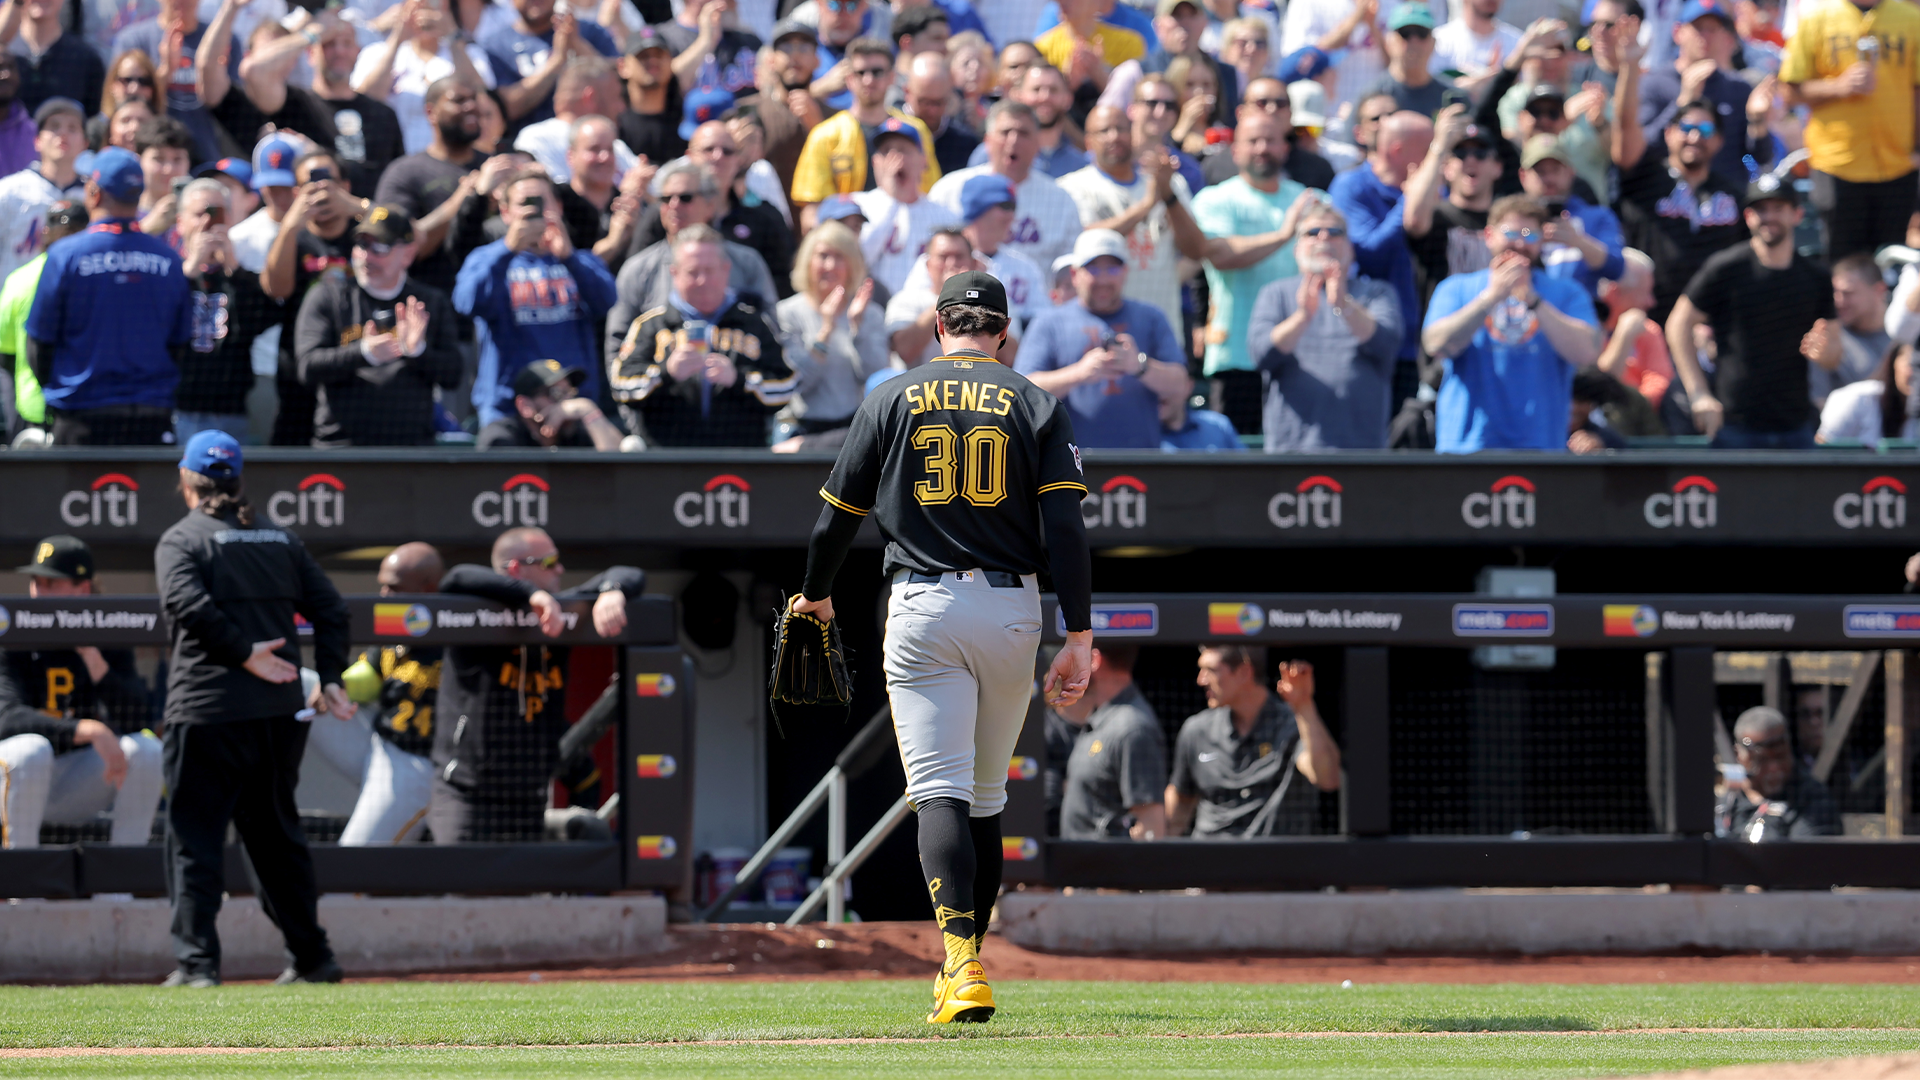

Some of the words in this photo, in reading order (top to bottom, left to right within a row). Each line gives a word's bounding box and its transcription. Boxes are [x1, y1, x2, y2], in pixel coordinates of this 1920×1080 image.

[78, 250, 172, 276] SECURITY
[905, 380, 1015, 416] SKENES
[911, 424, 1010, 507] 30
[60, 484, 138, 527] citi
[267, 484, 344, 527] citi
[472, 484, 548, 527] citi
[674, 485, 749, 527] citi
[1268, 486, 1341, 528] citi
[1461, 486, 1536, 528] citi
[1644, 486, 1717, 528] citi
[1833, 486, 1906, 528] citi
[15, 610, 54, 628] New
[56, 609, 94, 628] York
[95, 610, 157, 631] Lottery
[437, 610, 475, 628] New
[477, 609, 515, 628] York
[517, 609, 579, 630] Lory
[1269, 609, 1306, 627] New
[1306, 609, 1342, 627] York
[1343, 609, 1402, 631] Lottery
[1662, 610, 1700, 629] New
[1700, 610, 1736, 629] York
[1736, 610, 1795, 632] Lottery
[1851, 611, 1920, 631] mets.co
[46, 667, 75, 719] P
[929, 877, 941, 902] P
[967, 970, 983, 978] 30
